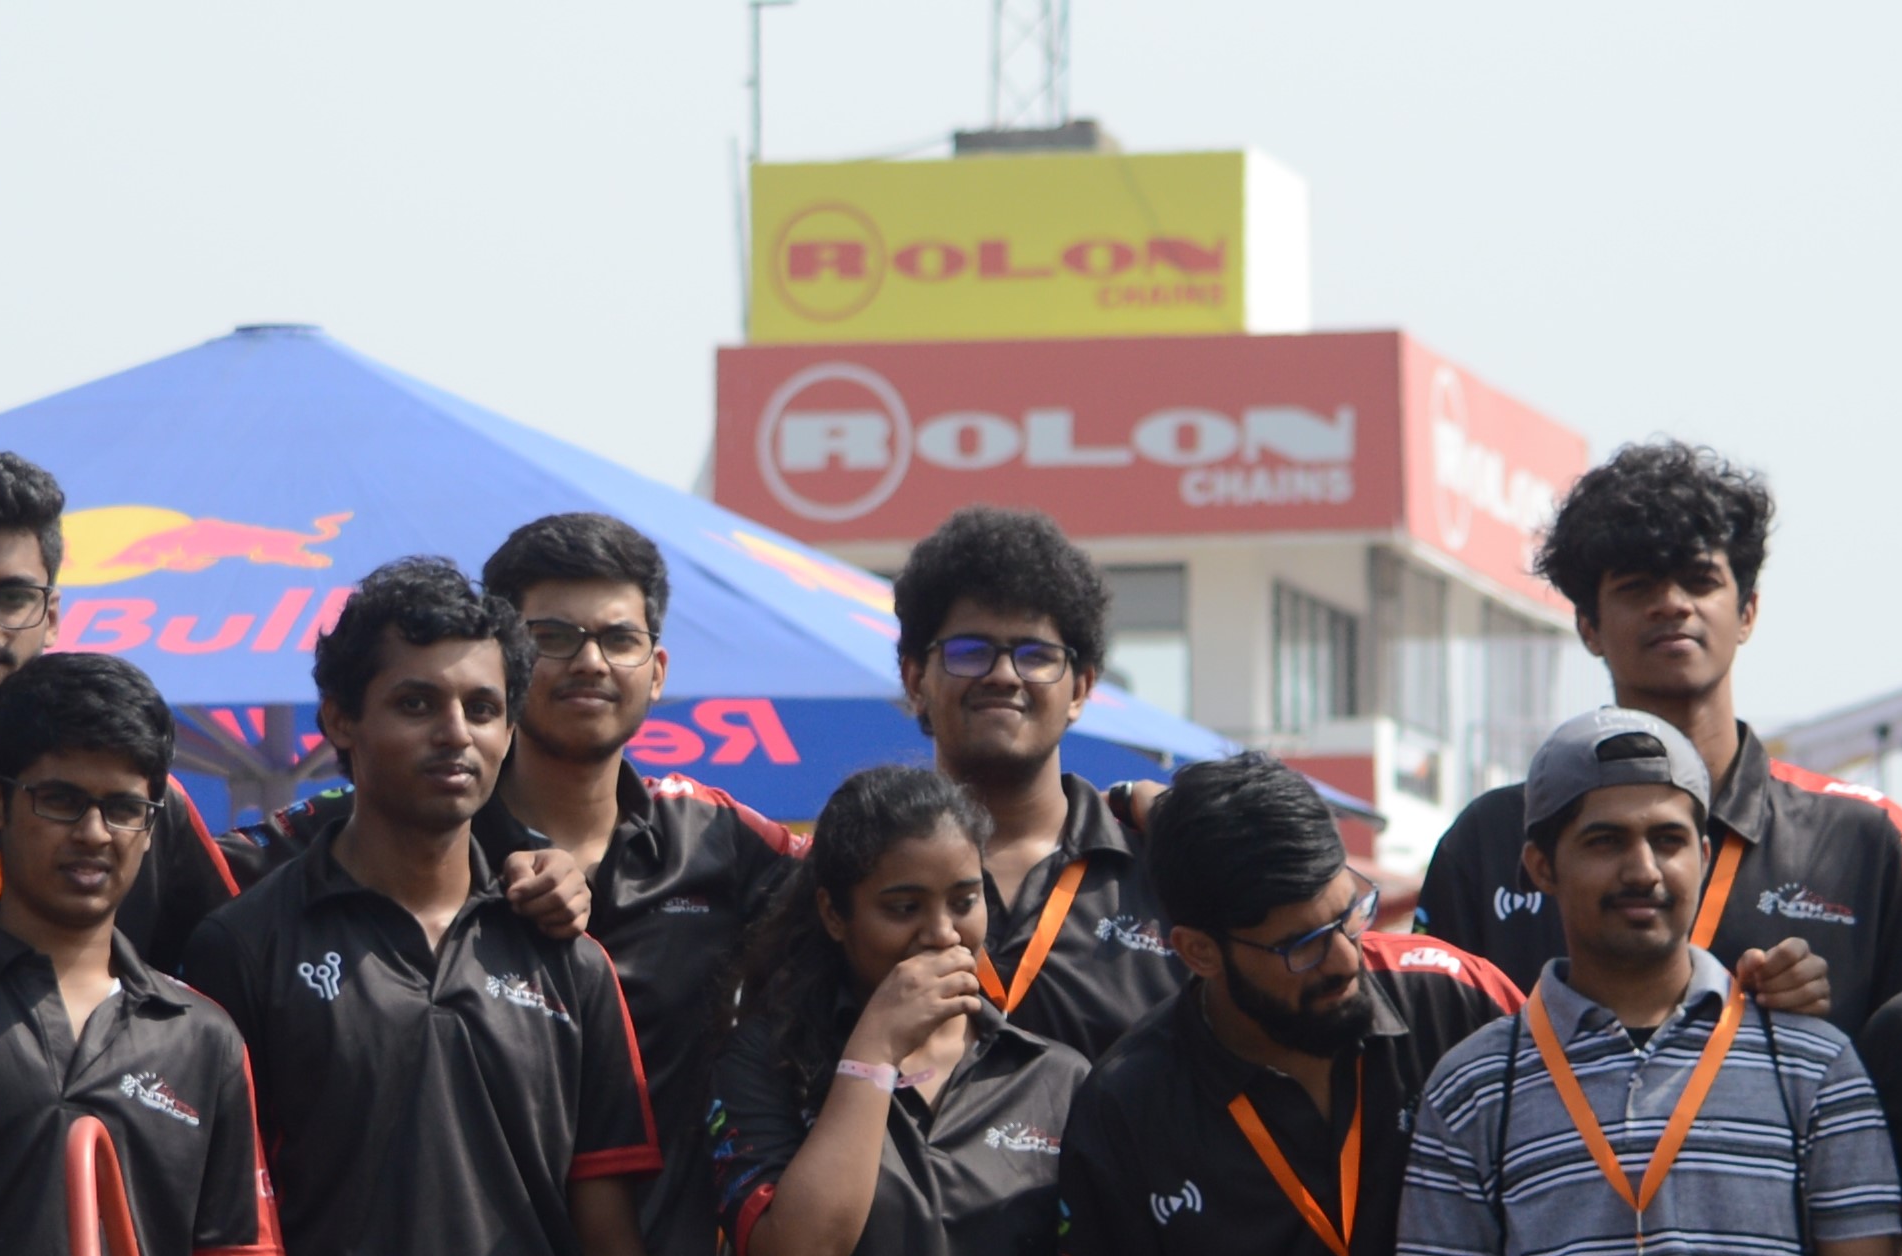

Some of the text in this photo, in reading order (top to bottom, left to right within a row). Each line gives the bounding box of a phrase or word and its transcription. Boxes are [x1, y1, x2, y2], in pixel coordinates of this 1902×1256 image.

[787, 236, 1226, 284] ROLON
[779, 406, 1355, 473] ROLON
[1178, 465, 1353, 507] CHAINS
